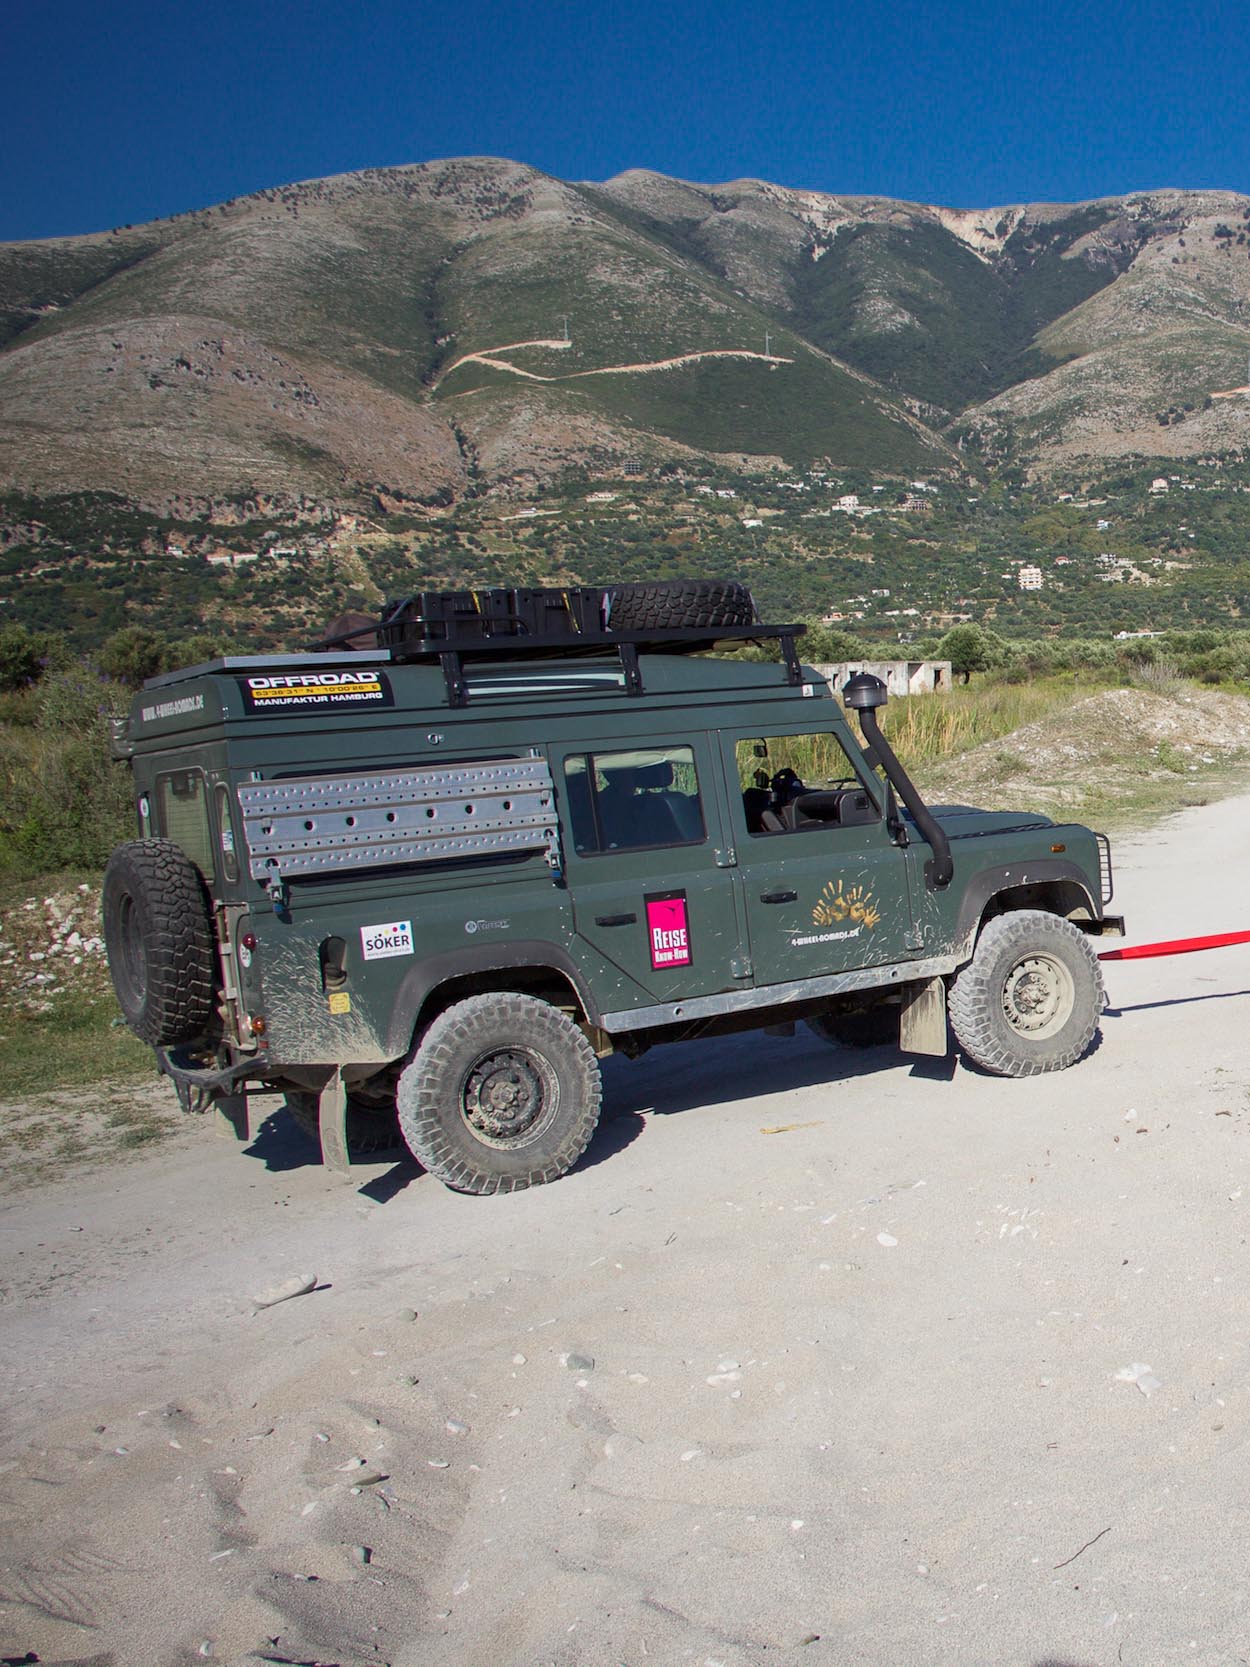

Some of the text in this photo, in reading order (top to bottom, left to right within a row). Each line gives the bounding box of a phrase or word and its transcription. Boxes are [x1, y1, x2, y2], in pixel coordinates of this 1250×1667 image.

[248, 672, 378, 688] OFFROAD
[254, 692, 383, 707] MANUFAKTUR HAMBURG
[366, 933, 410, 951] SÖKER
[653, 928, 687, 950] REISE
